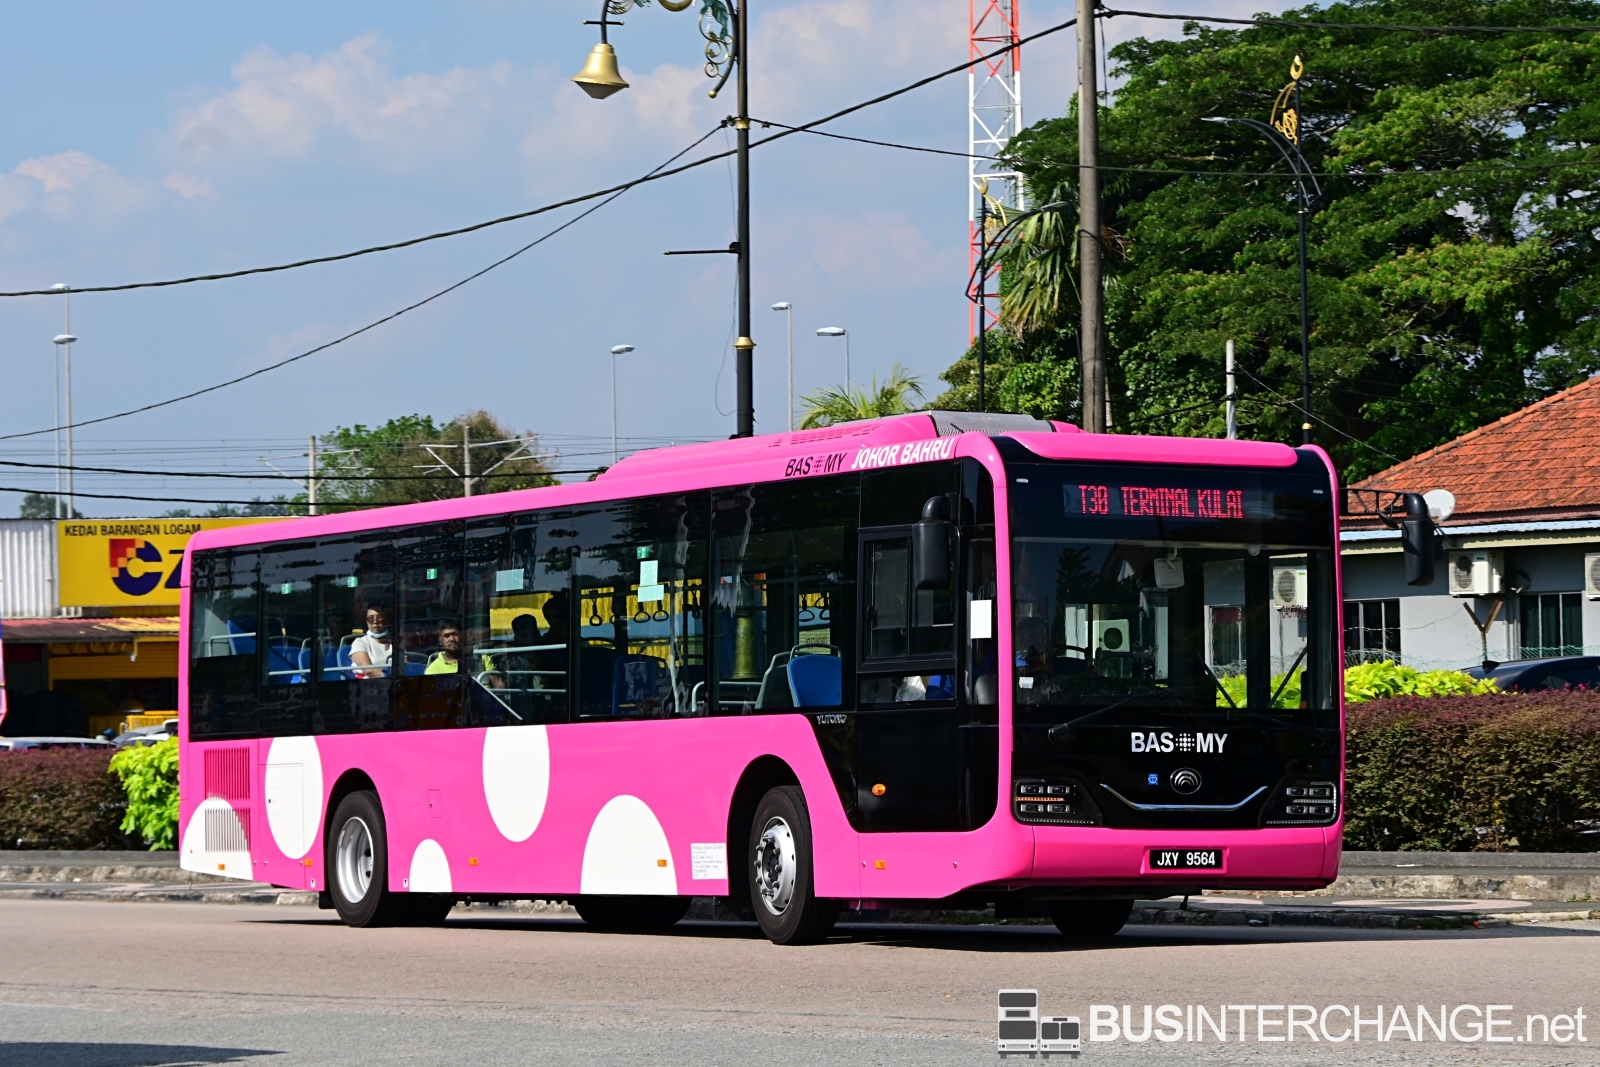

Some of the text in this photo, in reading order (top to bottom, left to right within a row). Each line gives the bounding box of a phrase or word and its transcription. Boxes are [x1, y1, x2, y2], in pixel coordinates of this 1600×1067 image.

[785, 438, 955, 477] BAS MY JOHOR BAHRU
[1078, 485, 1243, 519] T30 TERMINAL KULAI
[65, 523, 202, 537] KEDAI BARANGAN LOGAM
[816, 713, 847, 725] YUTONG
[1131, 731, 1229, 754] BAS MY
[1157, 851, 1216, 867] JXY 9564
